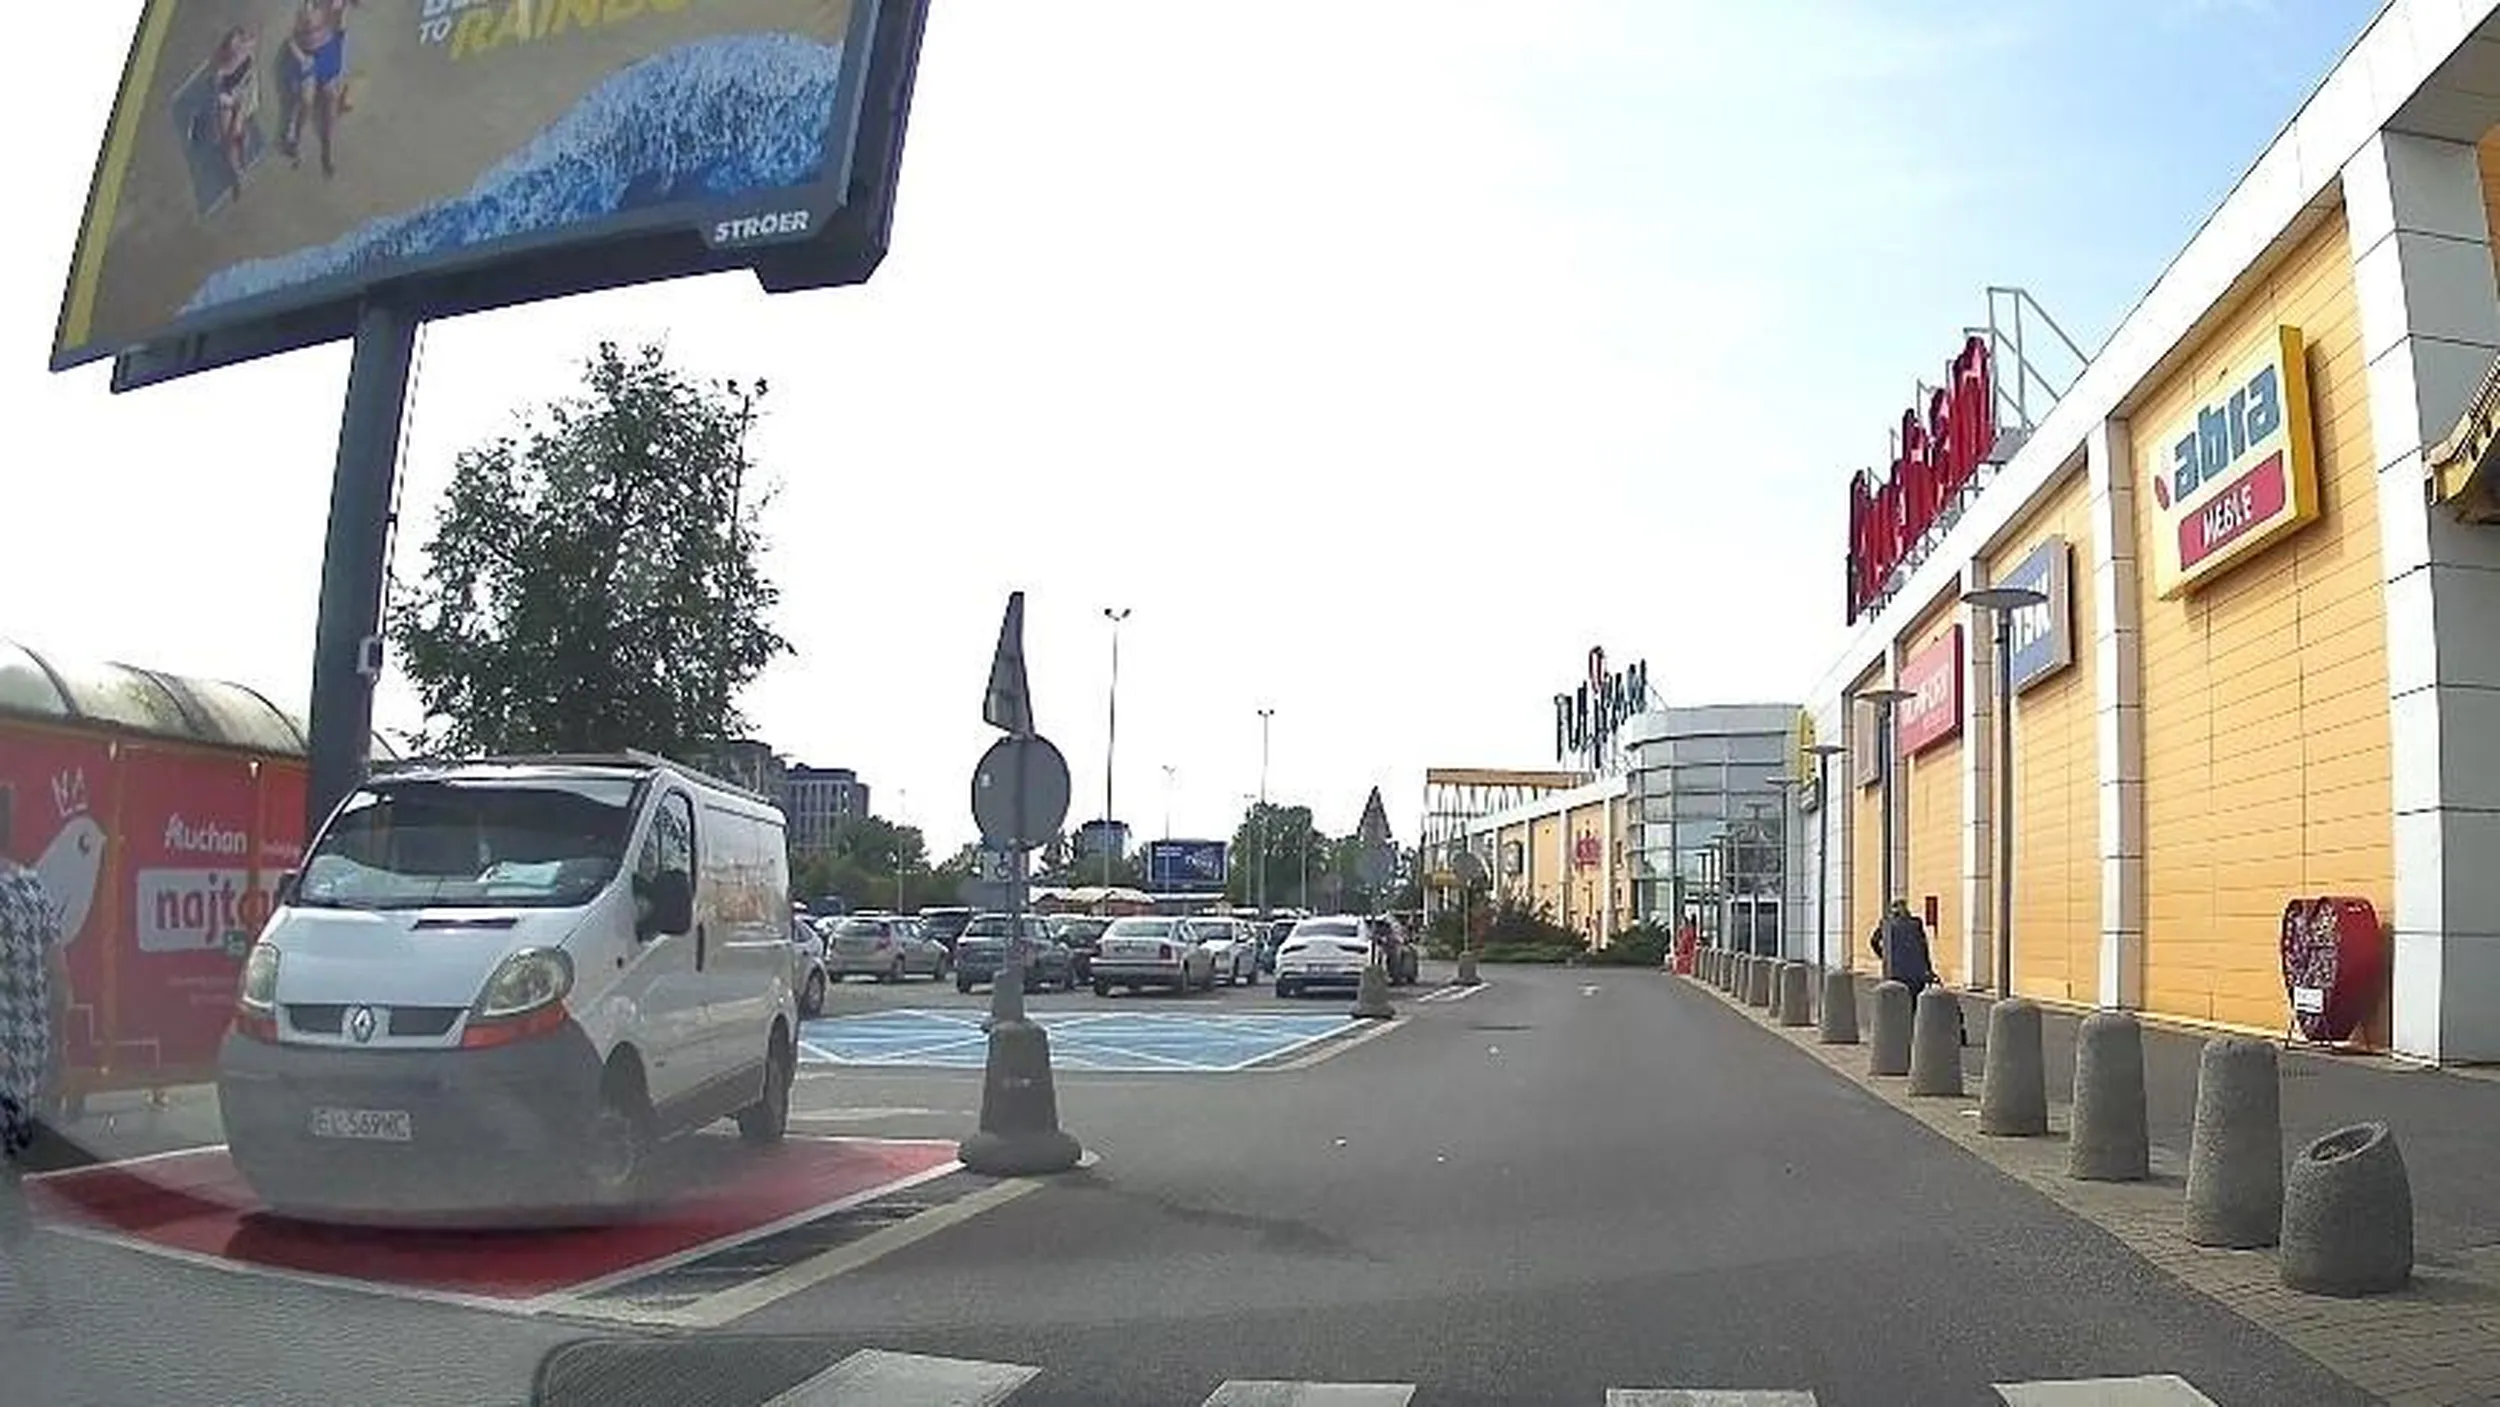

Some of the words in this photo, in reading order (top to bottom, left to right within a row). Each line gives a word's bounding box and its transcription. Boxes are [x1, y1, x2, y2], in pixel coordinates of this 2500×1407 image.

[419, 16, 451, 45] TO
[2174, 362, 2282, 503] abra
[2202, 480, 2254, 548] MEBLE
[163, 811, 249, 854] Auchan
